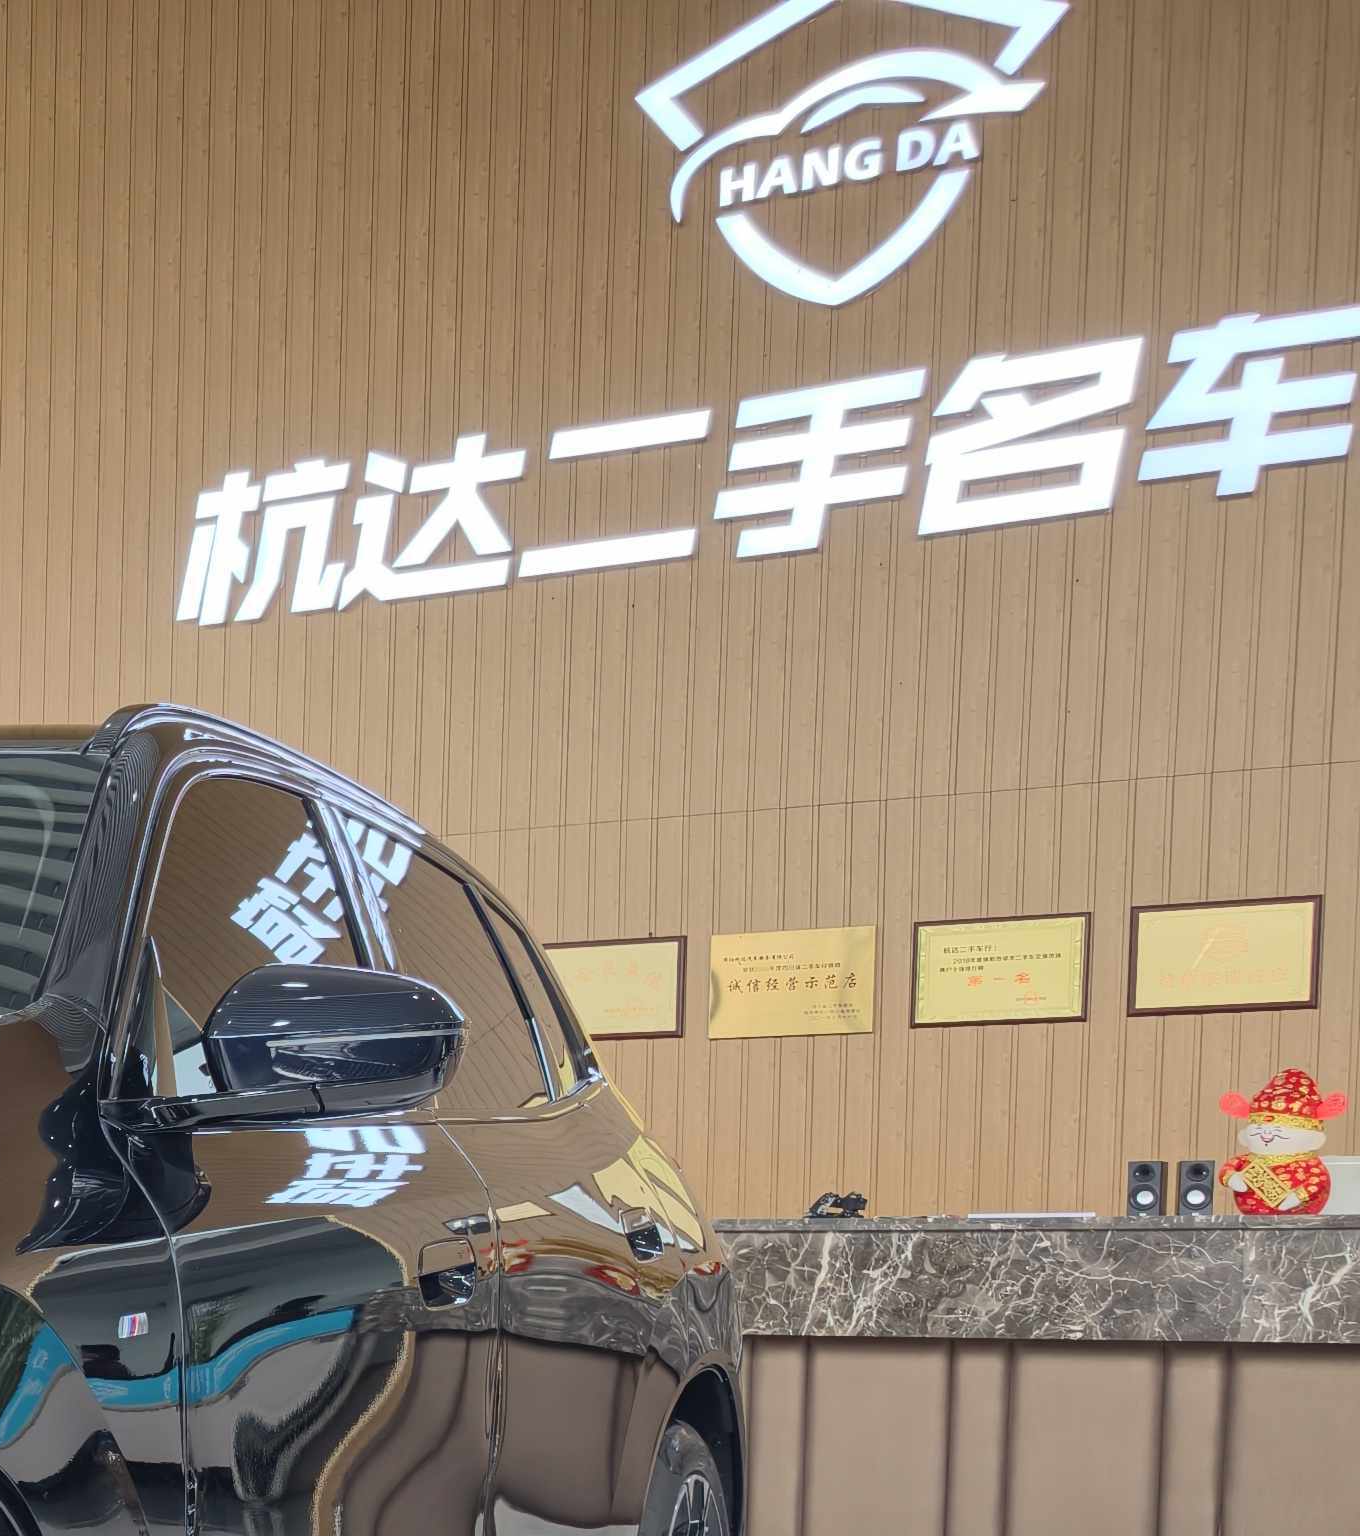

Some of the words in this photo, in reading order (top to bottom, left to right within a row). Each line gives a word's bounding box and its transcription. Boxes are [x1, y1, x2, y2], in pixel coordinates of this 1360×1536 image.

[718, 133, 884, 208] HANG
[896, 121, 981, 174] DA
[176, 305, 1360, 627] 杭达二手名车
[728, 972, 857, 994] 诚信经营示范店
